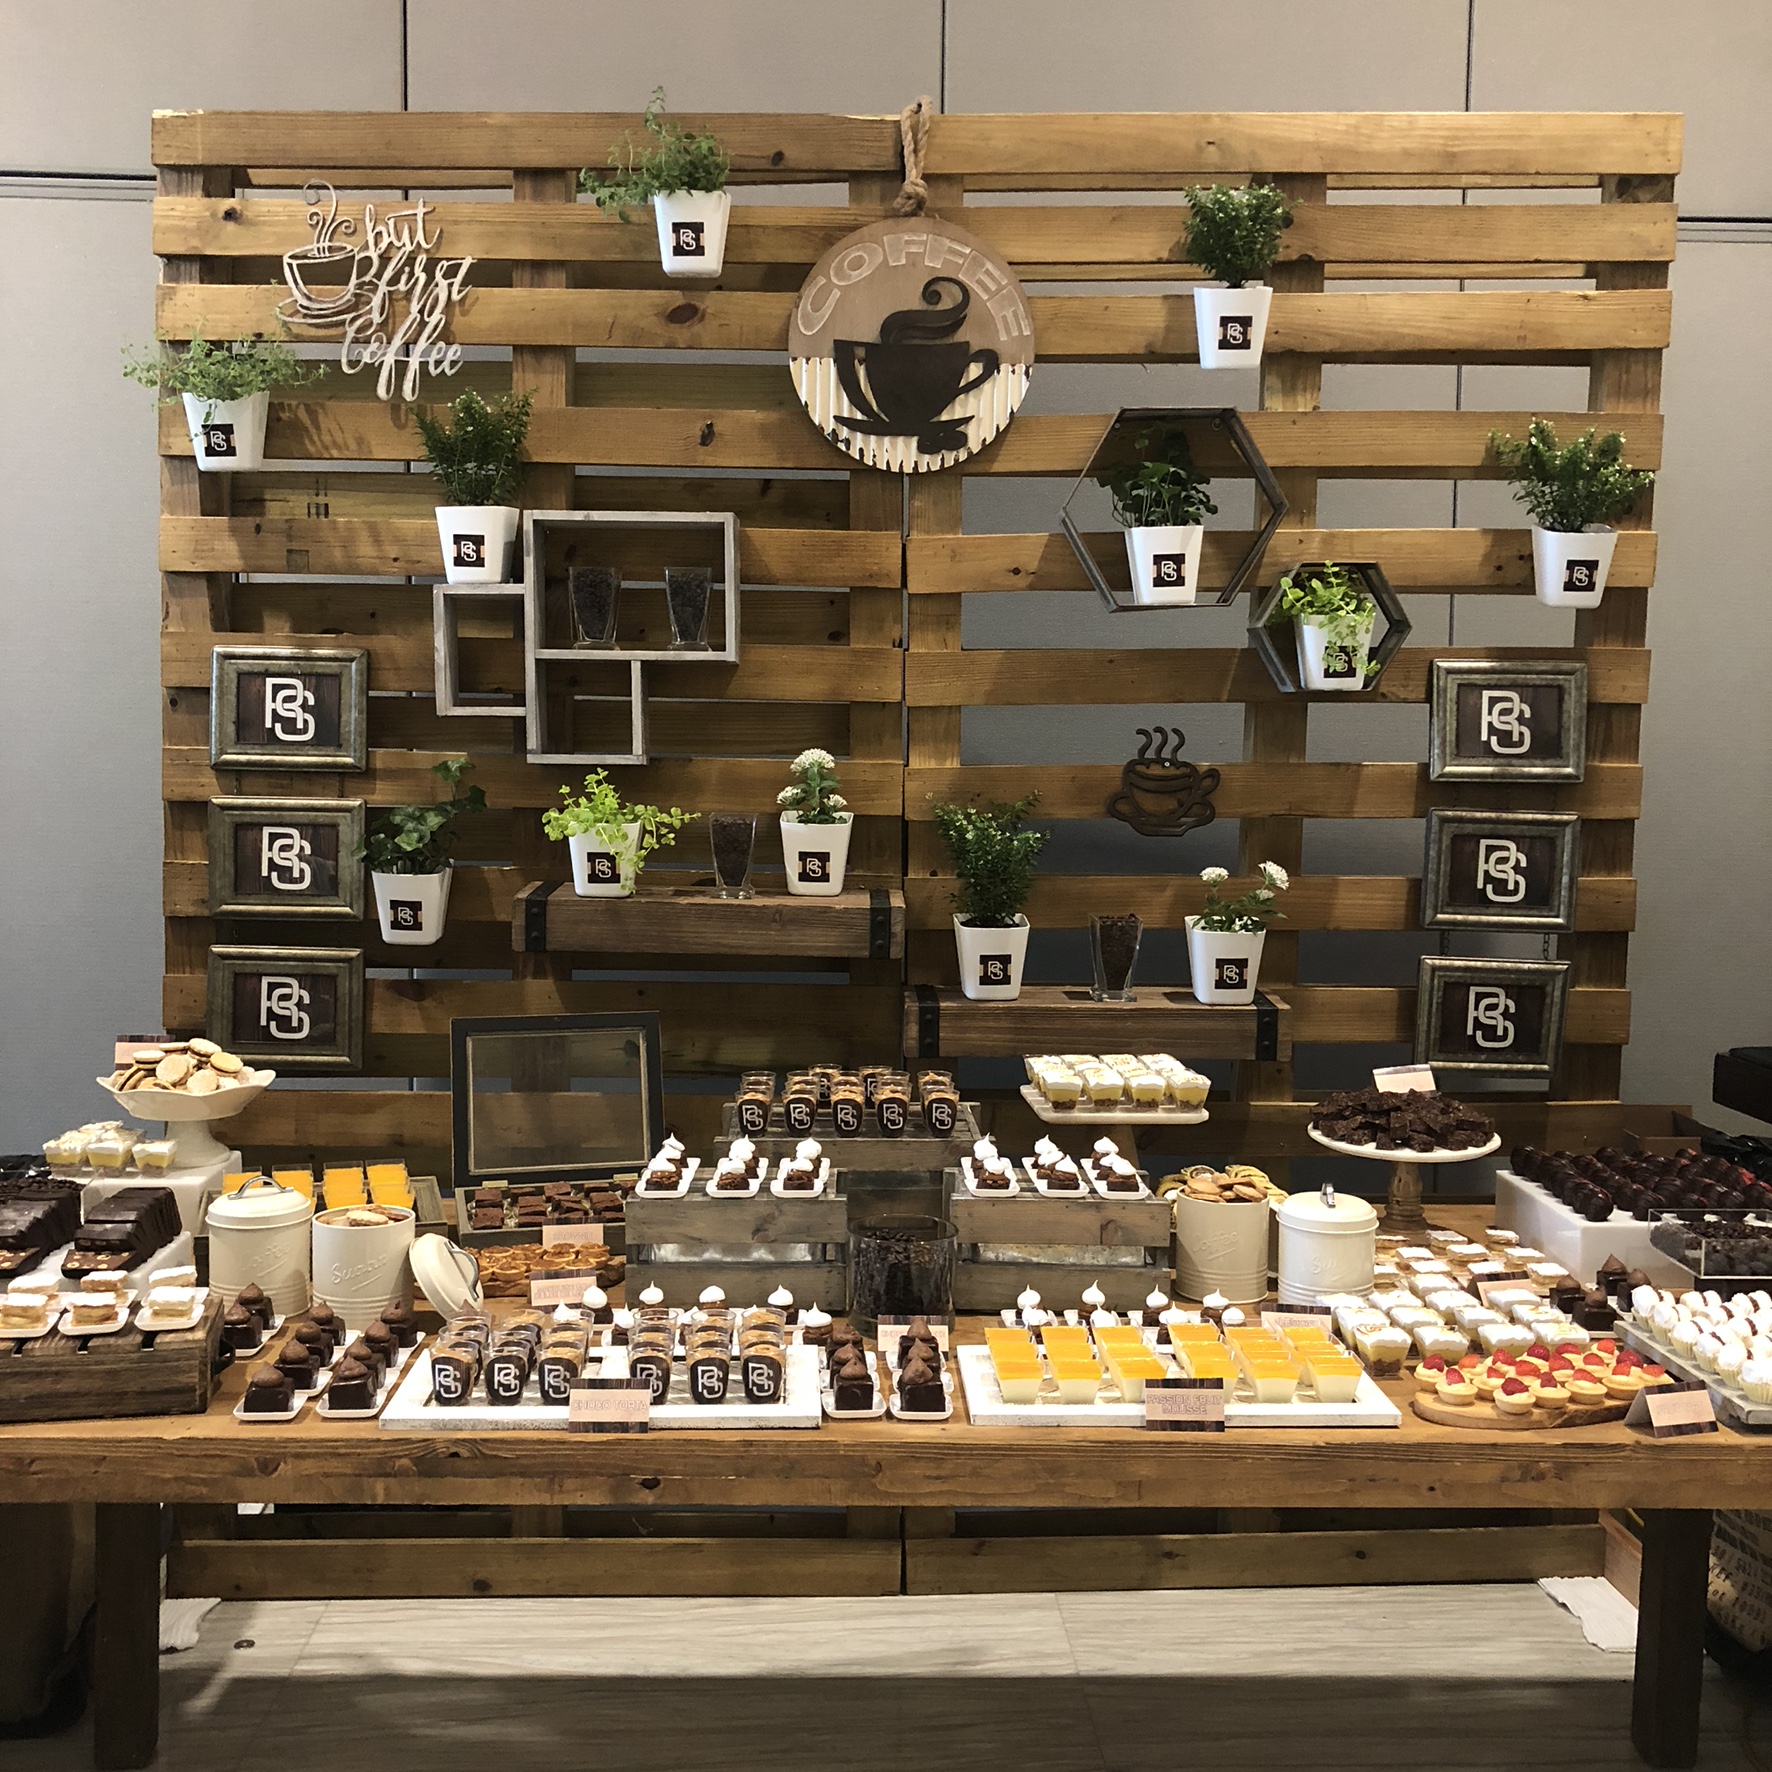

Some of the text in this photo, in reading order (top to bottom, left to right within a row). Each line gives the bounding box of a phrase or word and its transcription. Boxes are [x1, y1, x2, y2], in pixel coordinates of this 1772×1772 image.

[362, 198, 441, 256] but
[371, 248, 478, 324] first
[797, 233, 1031, 341] COFFEE
[341, 313, 463, 401] Coffee
[571, 1399, 648, 1411] CHOCO TORTA
[1146, 1394, 1192, 1405] PASSION
[1161, 1403, 1208, 1415] MOUSSE
